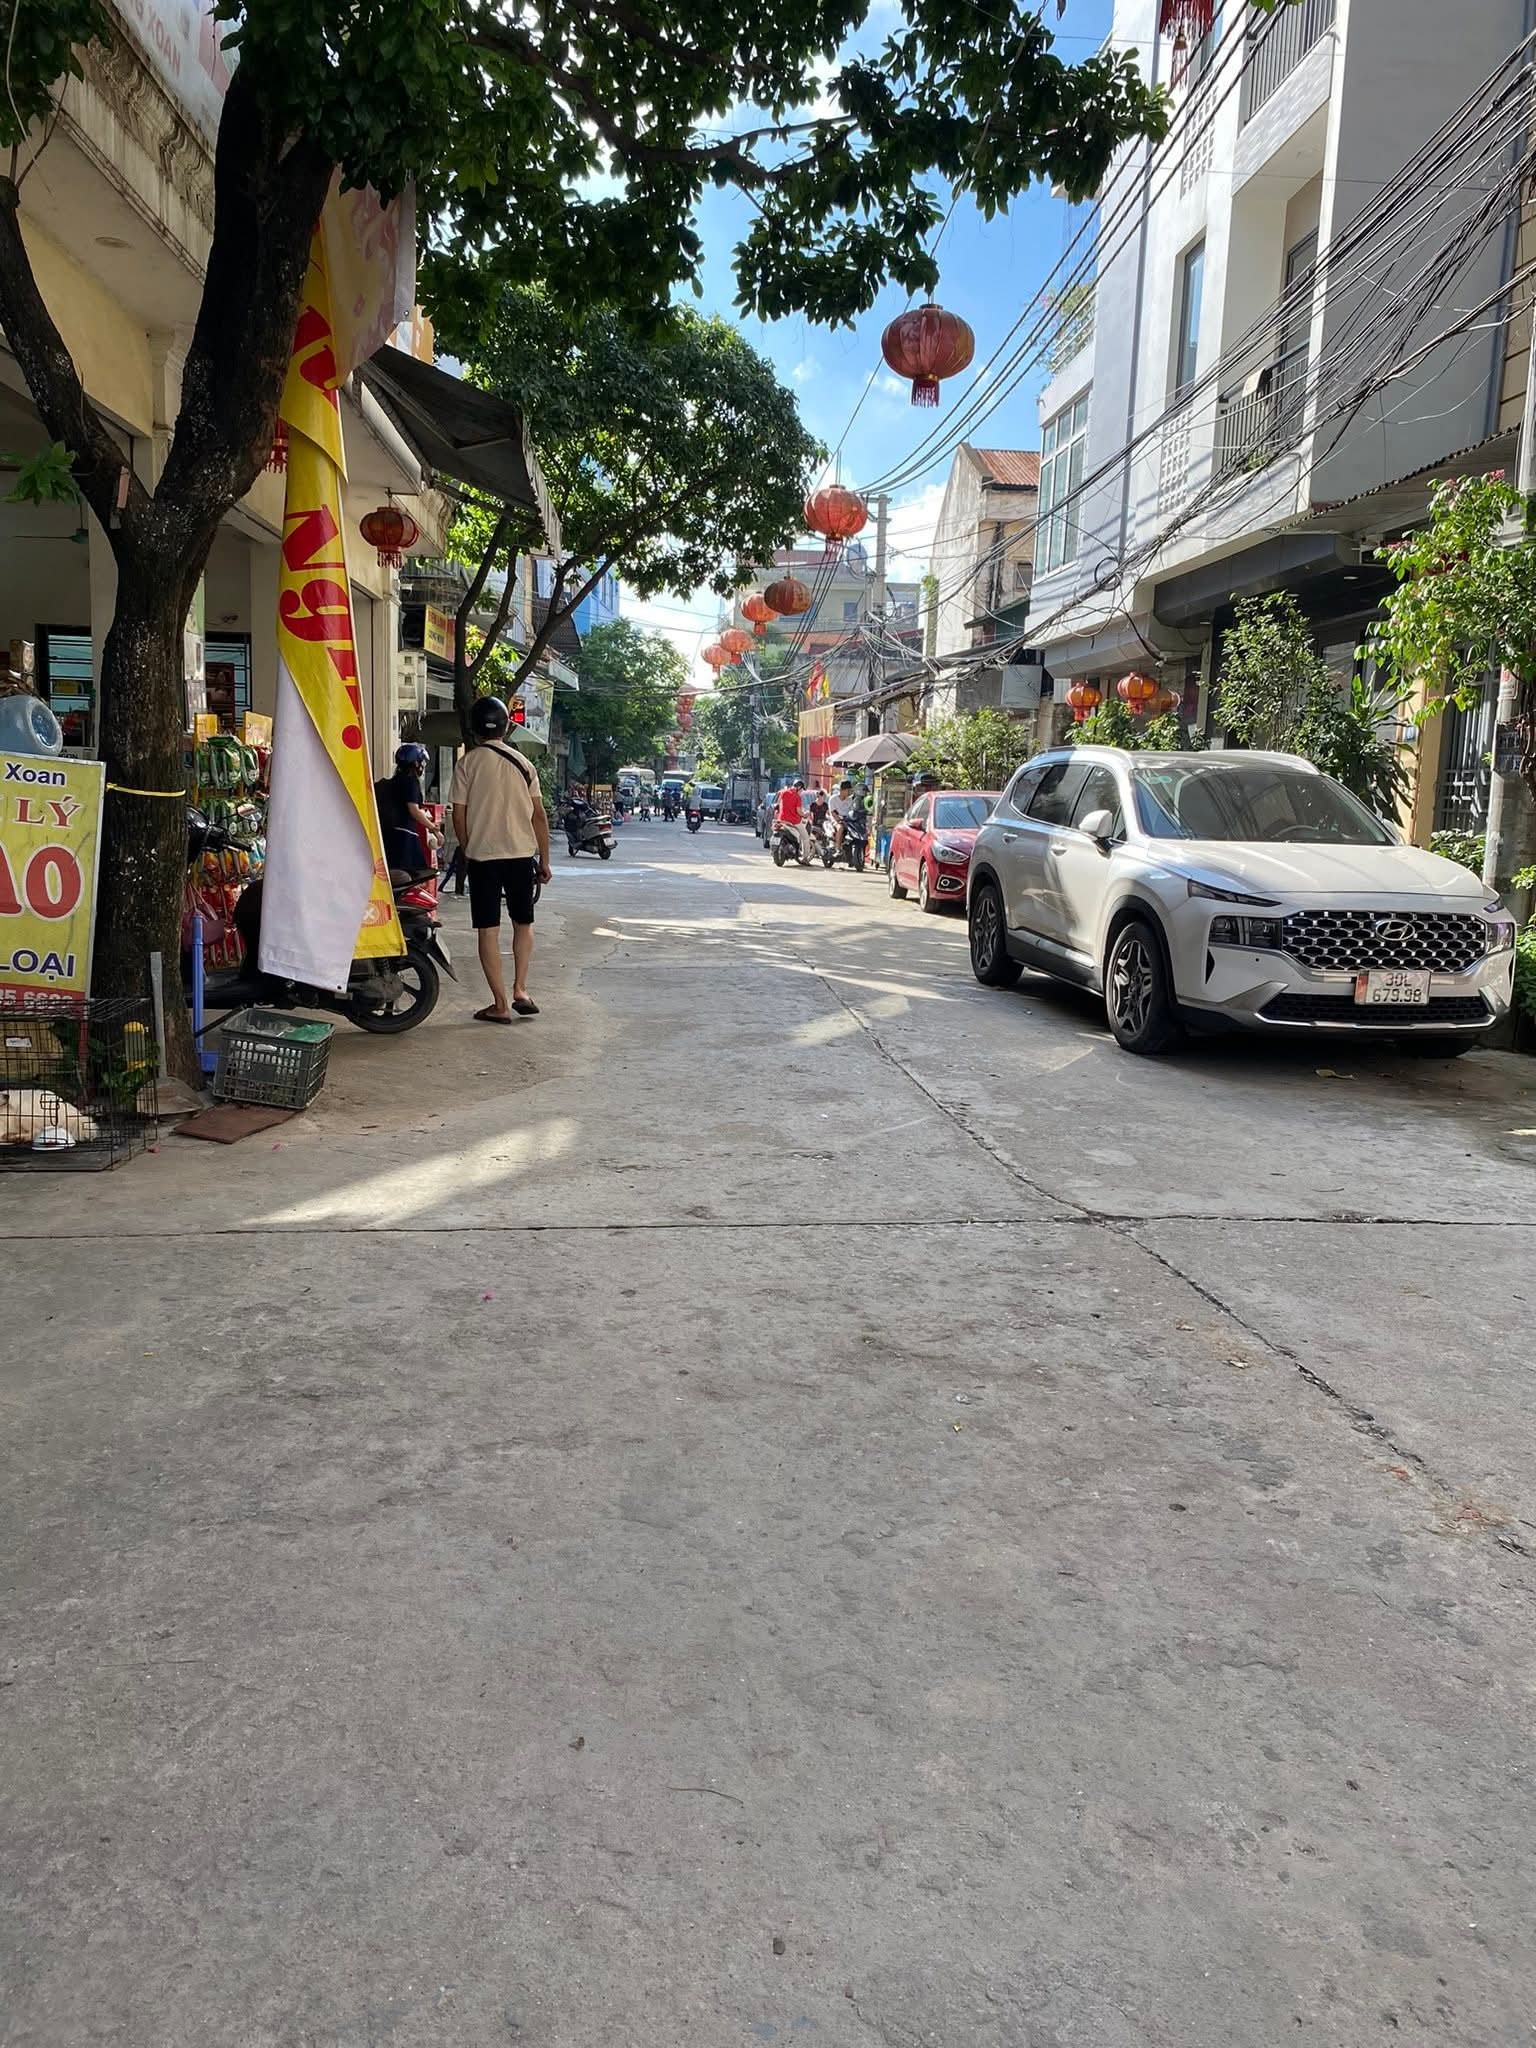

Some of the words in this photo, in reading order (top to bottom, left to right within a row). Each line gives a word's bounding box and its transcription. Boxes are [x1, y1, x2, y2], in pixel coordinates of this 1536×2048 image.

[5, 762, 65, 785] Xoan
[15, 796, 81, 827] LÝ
[0, 949, 74, 980] OẠI
[1385, 973, 1412, 986] 30L
[1372, 988, 1421, 1003] 679.98
